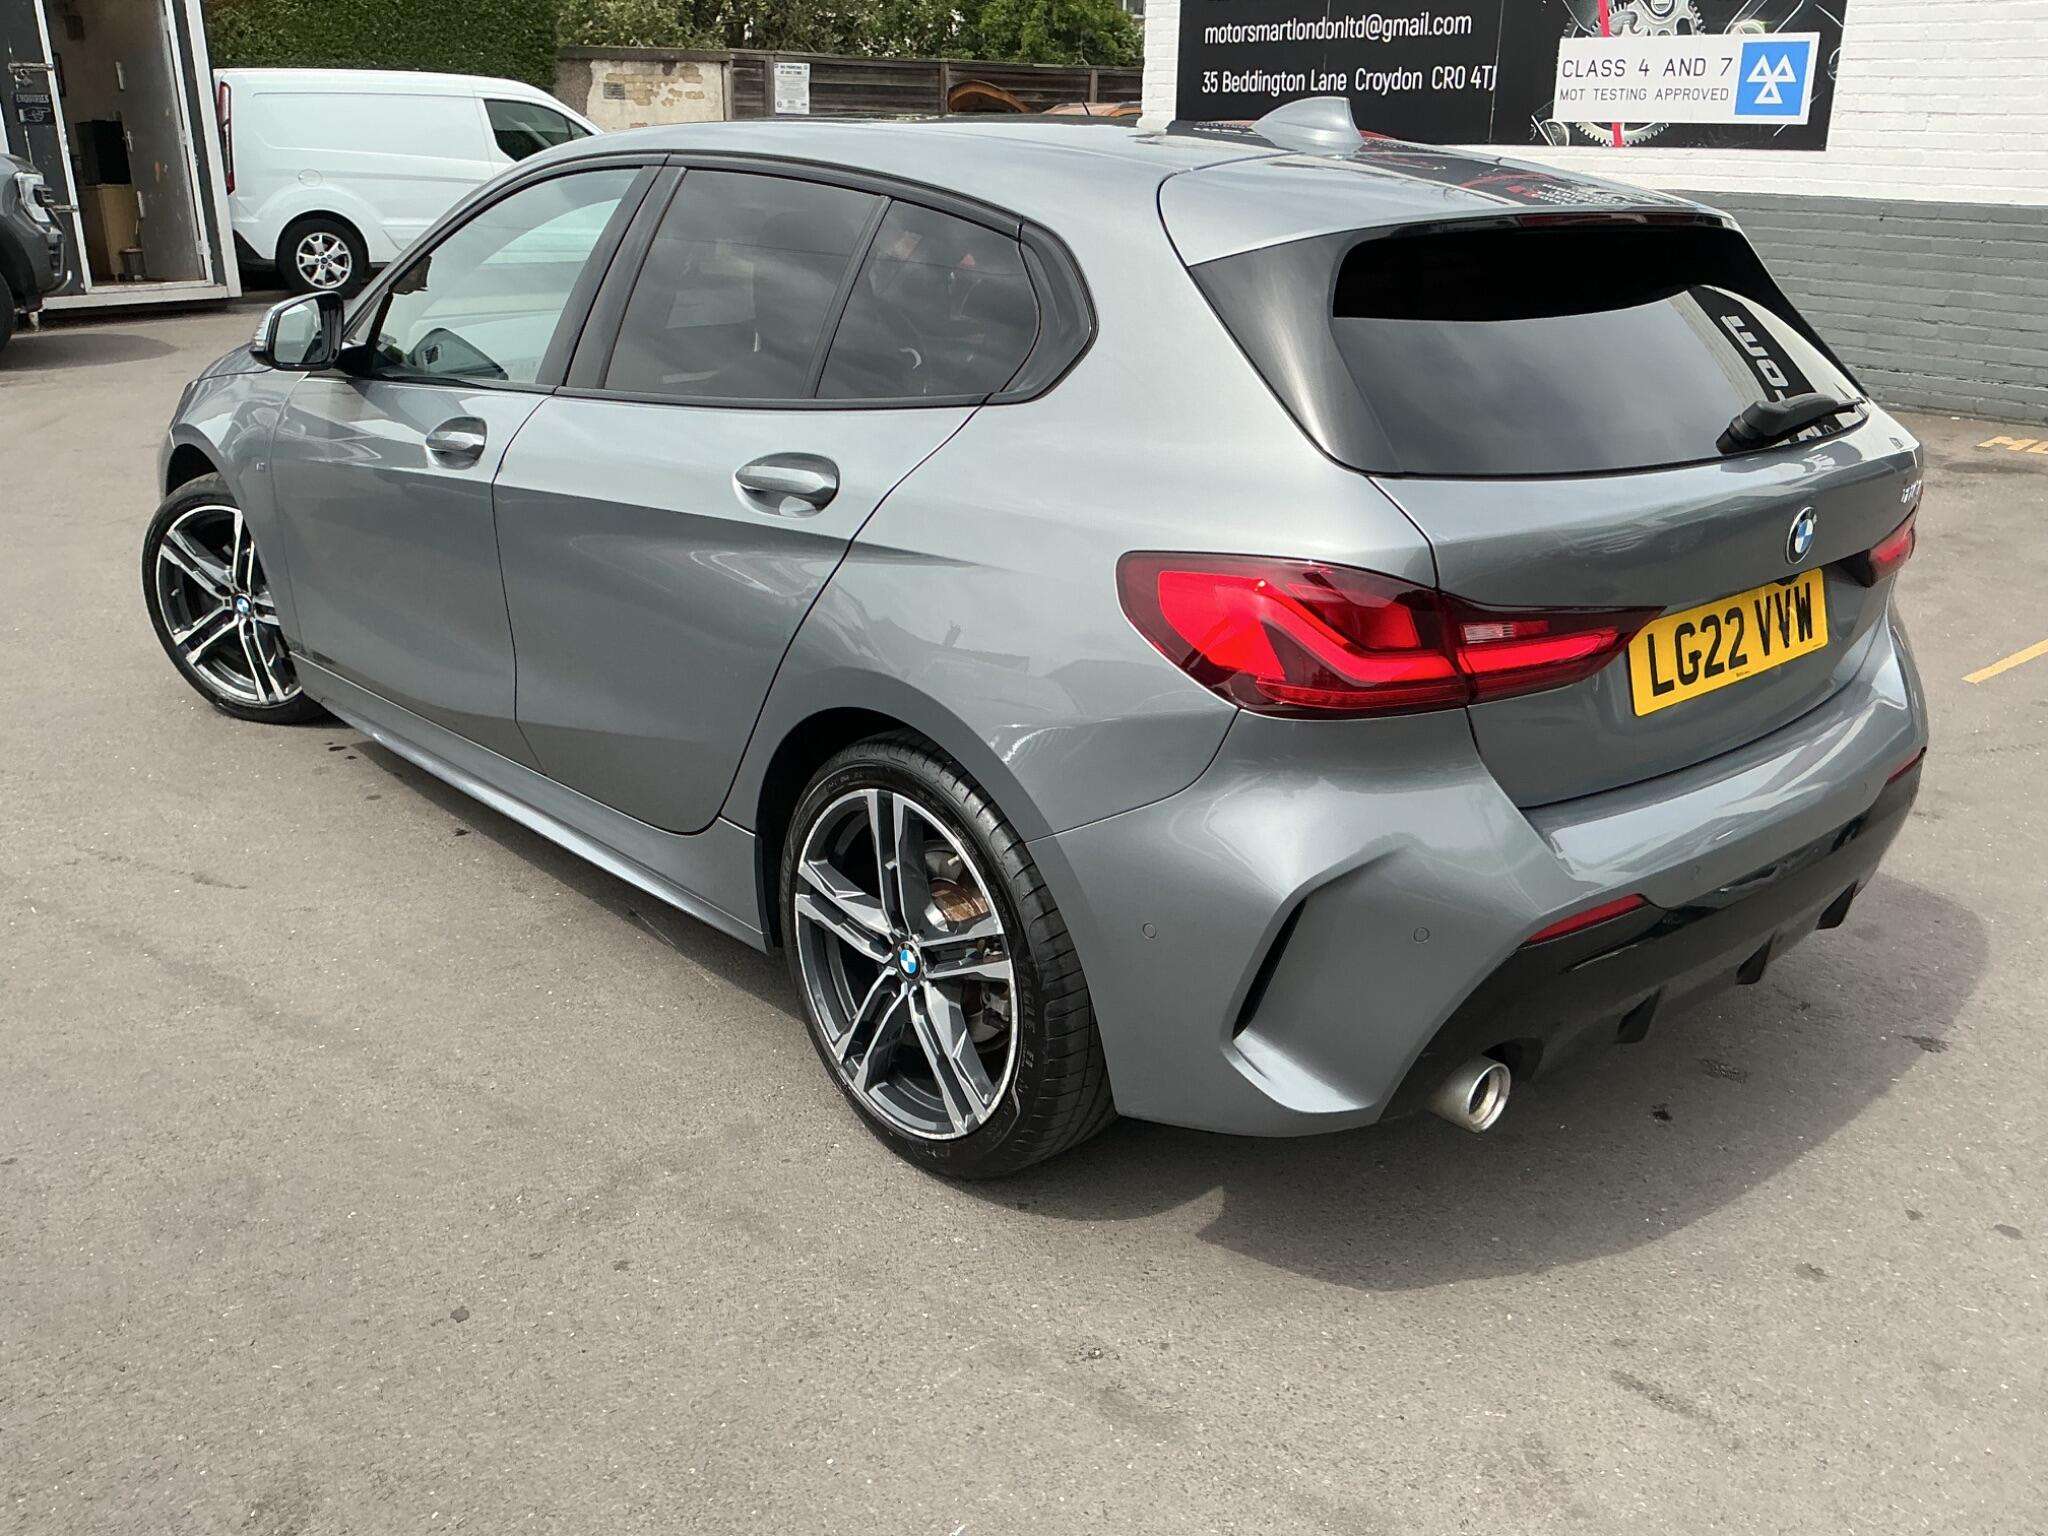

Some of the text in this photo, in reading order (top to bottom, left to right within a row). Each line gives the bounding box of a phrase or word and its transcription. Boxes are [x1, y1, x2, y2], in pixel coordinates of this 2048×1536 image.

[1204, 12, 1472, 45] motorsmartlondonltd@gmail.com
[1201, 70, 1219, 94] 35
[1222, 69, 1306, 97] Beddington
[1310, 68, 1348, 92] Lane
[1354, 66, 1423, 96] Croydon
[1470, 64, 1497, 91] 4TJ
[1562, 57, 1734, 78] CLASS 4 AND 7
[1559, 87, 1729, 101] MOT TESTING APPROVED
[1647, 581, 1813, 697] LG22 VVW
